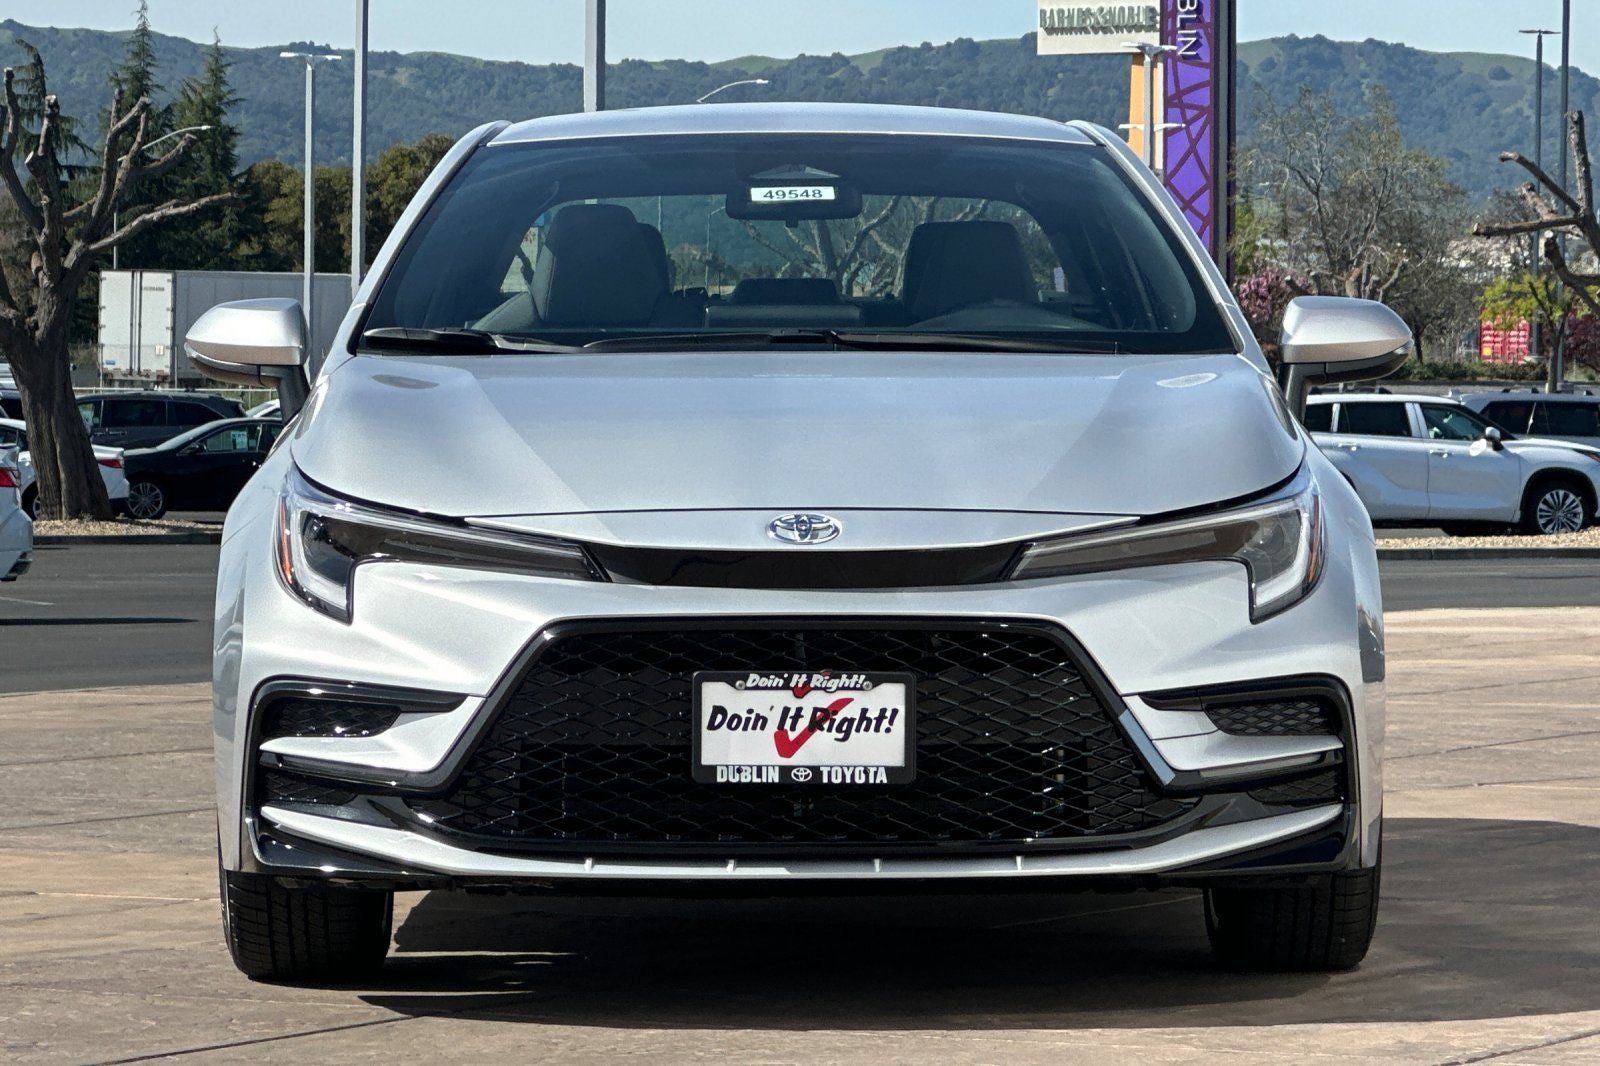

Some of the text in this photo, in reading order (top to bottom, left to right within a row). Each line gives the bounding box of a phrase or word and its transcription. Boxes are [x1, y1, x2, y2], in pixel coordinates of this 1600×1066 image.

[763, 189, 823, 199] 49548
[746, 673, 864, 692] Doin' It Right!
[707, 705, 899, 742] Doin' It Right!
[716, 766, 888, 784] DUBLIN TOYOTA
